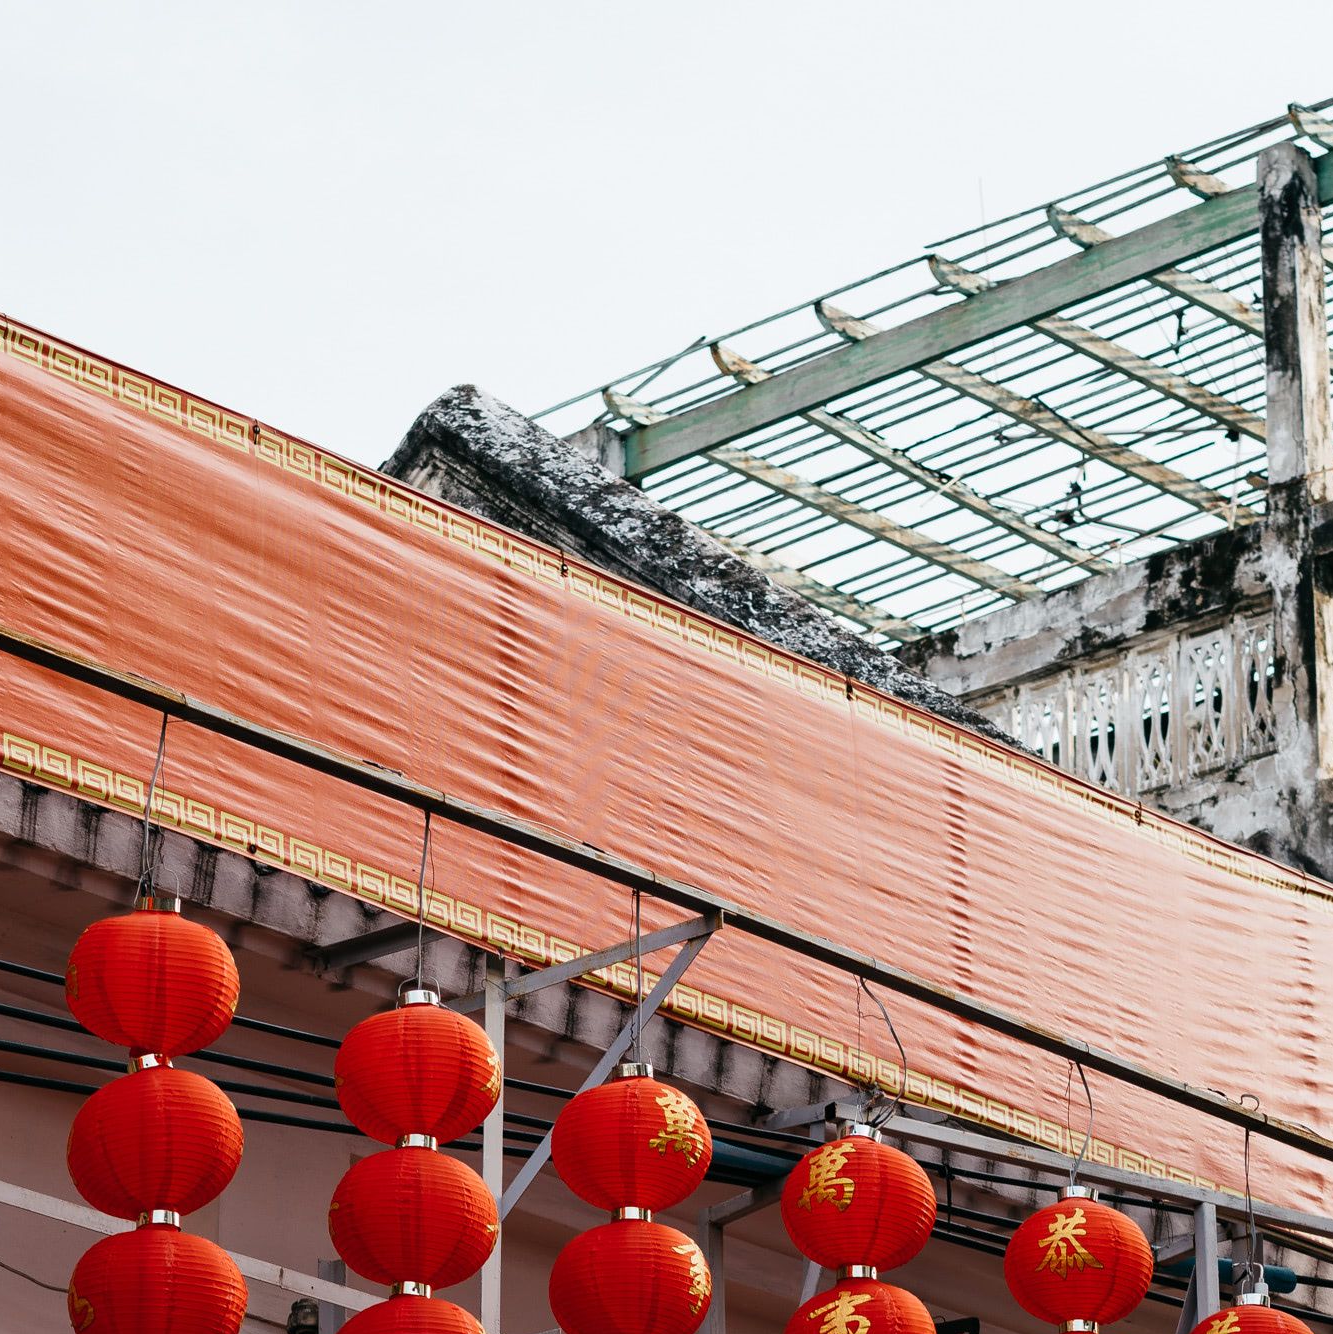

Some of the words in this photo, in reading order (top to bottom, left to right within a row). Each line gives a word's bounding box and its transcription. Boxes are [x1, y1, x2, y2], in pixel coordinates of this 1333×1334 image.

[648, 1086, 706, 1168] 萬
[796, 1140, 857, 1215] 萬
[1034, 1206, 1105, 1280] 恭
